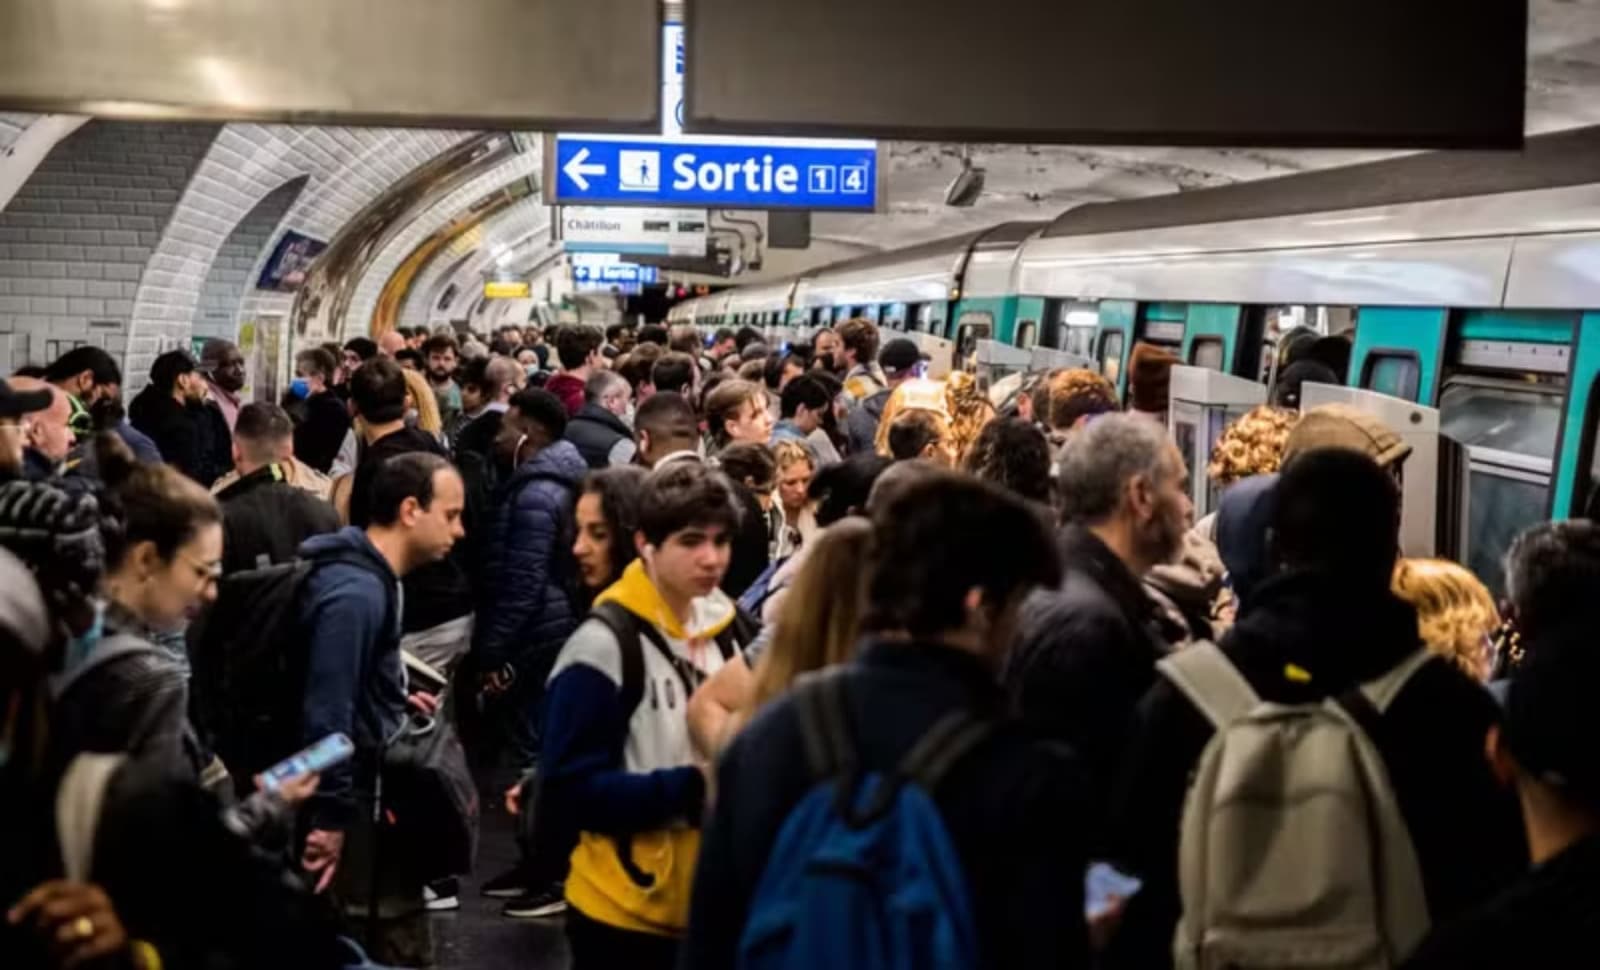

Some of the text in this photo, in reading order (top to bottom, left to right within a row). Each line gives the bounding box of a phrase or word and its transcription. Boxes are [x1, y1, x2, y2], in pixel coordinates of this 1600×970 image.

[673, 153, 862, 192] Sortie 1 4
[567, 219, 621, 231] Châtillon
